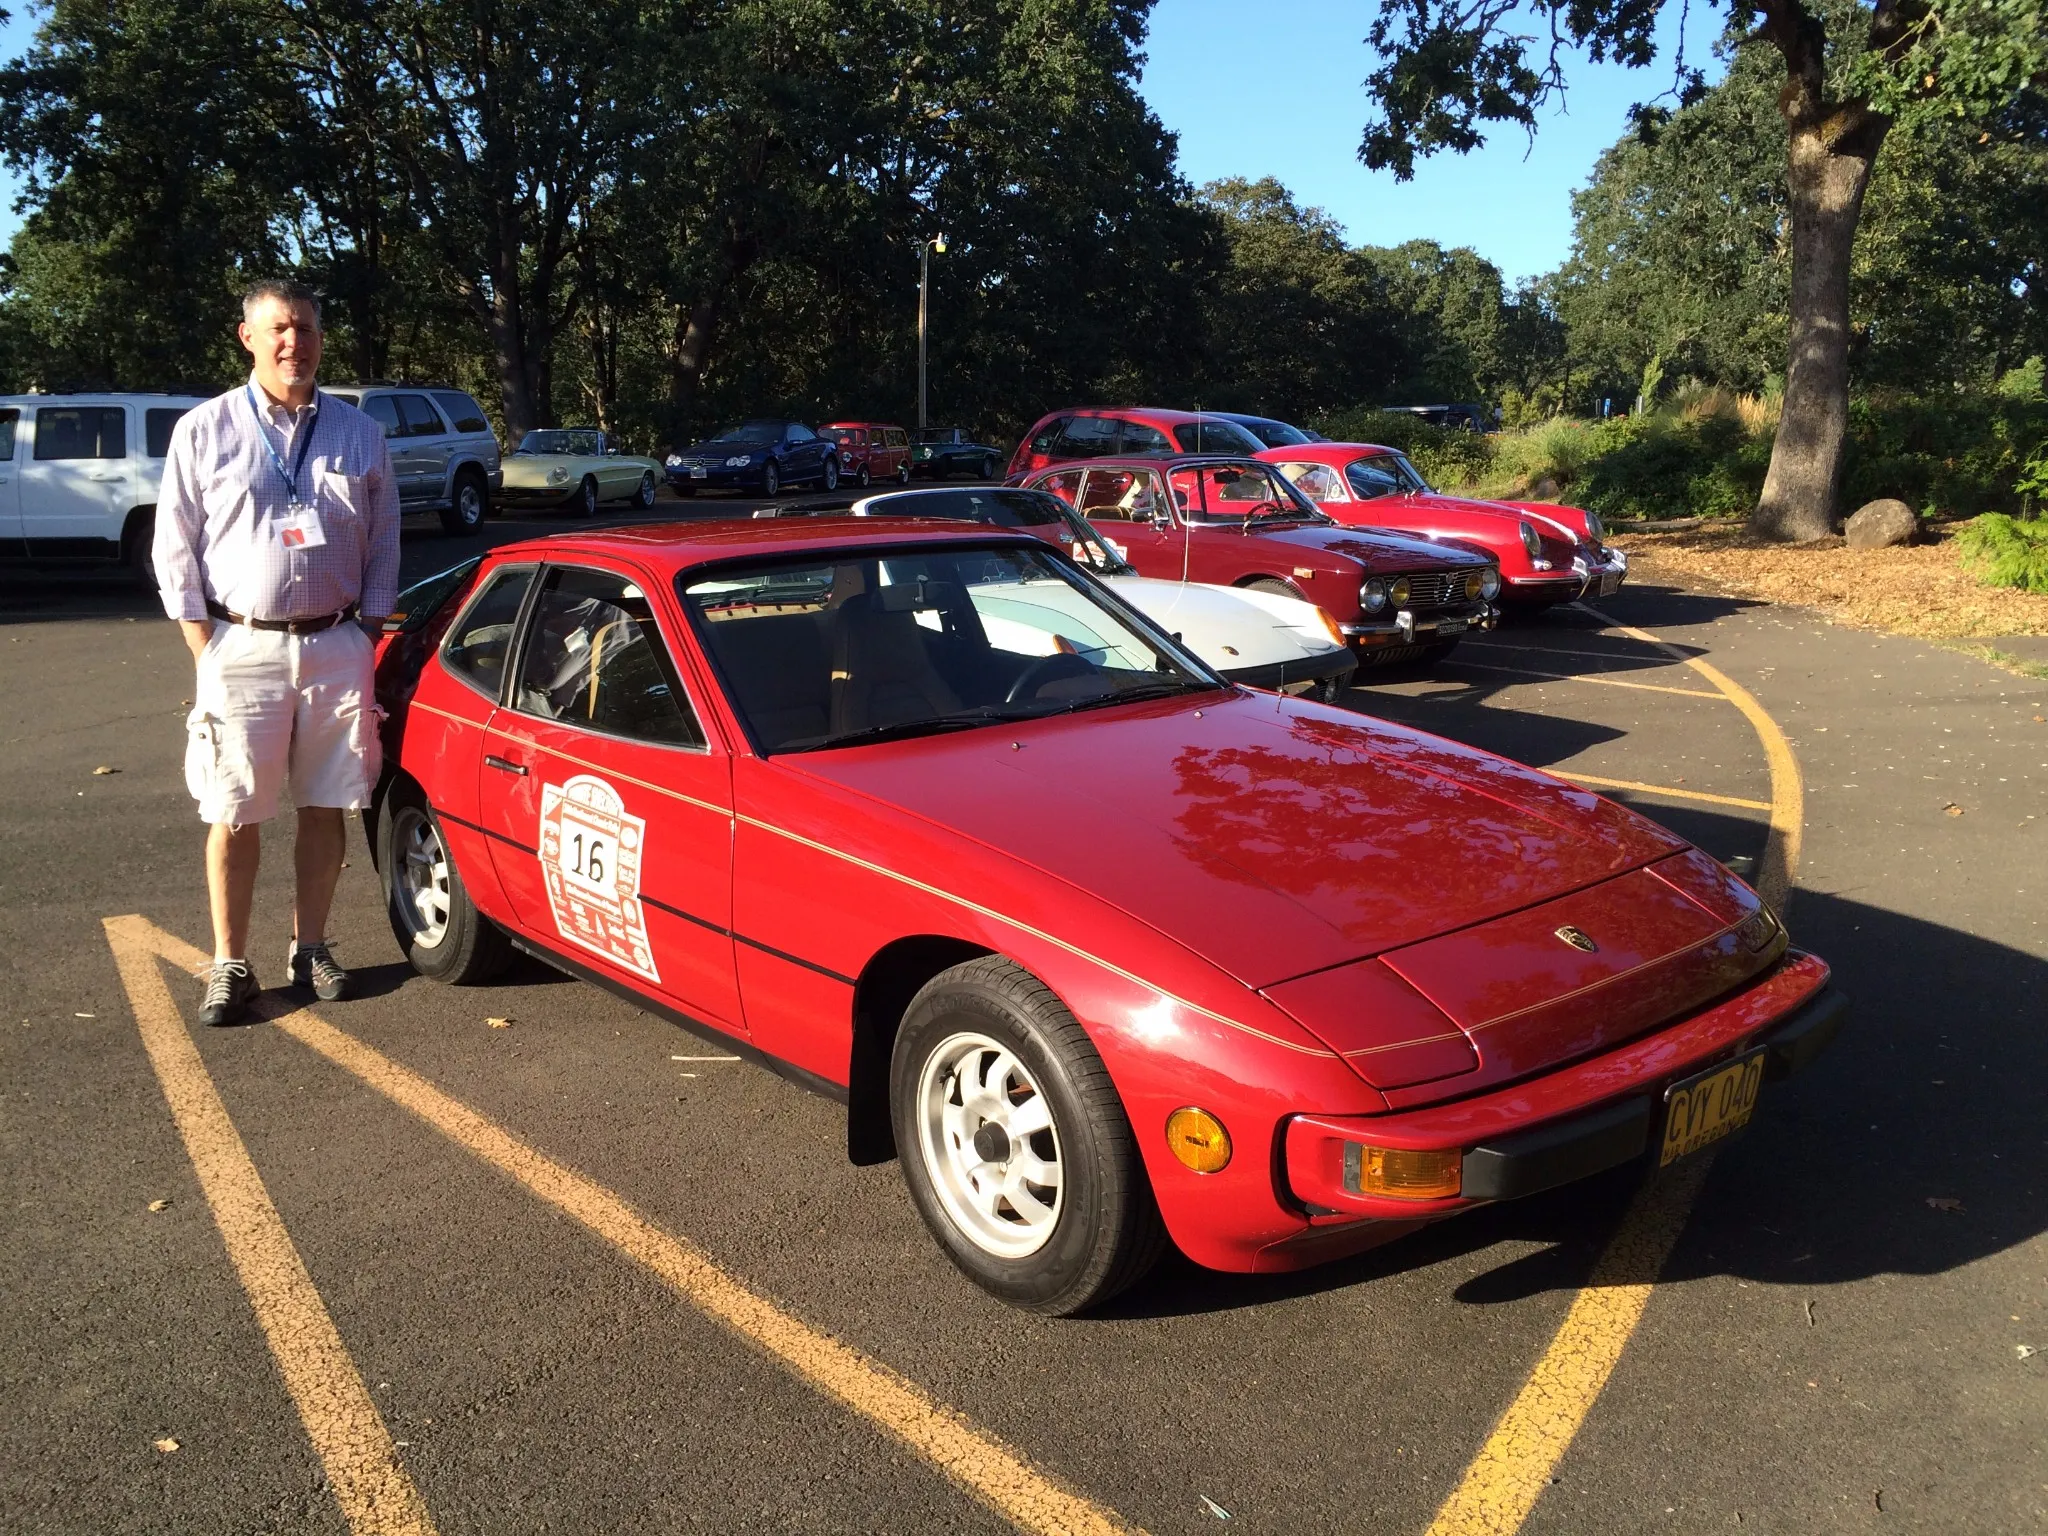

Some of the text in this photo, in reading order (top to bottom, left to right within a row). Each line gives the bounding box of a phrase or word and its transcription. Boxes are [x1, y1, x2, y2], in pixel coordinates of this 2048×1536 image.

[571, 833, 604, 883] 16
[1669, 1063, 1759, 1142] CVY 040
